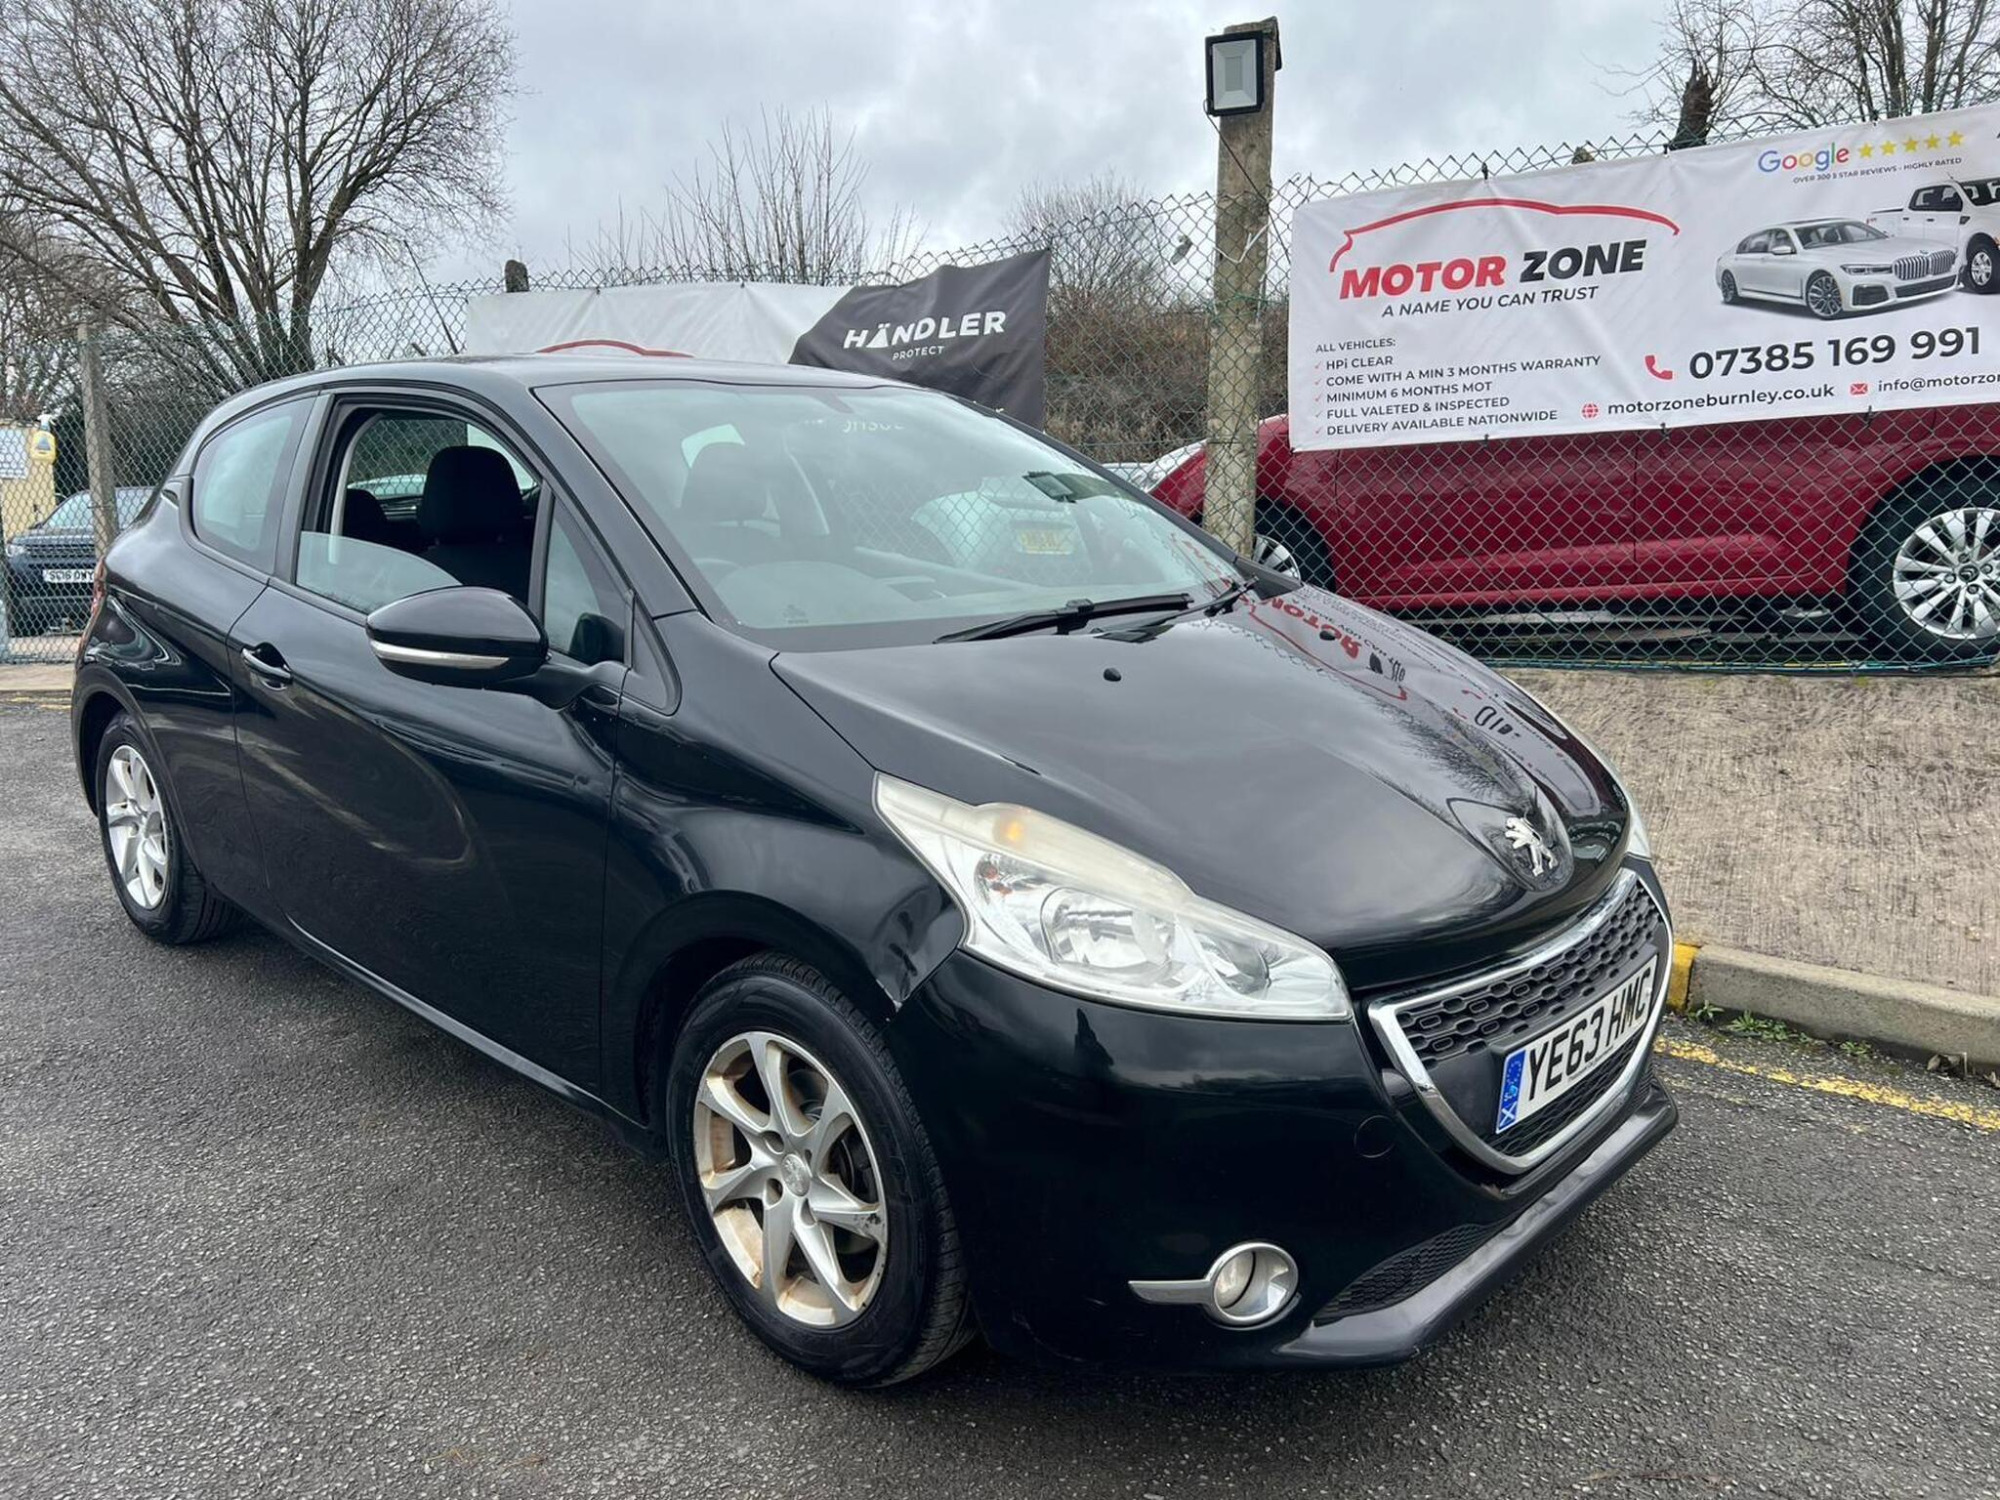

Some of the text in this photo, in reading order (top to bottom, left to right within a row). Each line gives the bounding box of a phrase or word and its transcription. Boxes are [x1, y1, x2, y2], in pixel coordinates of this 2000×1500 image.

[1758, 142, 1850, 172] Google
[1793, 175, 1815, 184] OVER
[1838, 170, 1859, 179] STAR
[1860, 166, 1897, 176] REVIEWS
[1903, 161, 1934, 170] HIGHLY
[1934, 157, 1962, 166] RATED
[1339, 239, 1647, 300] MOTOR ZONE
[1381, 286, 1599, 318] A NAME YOU CAN TRUST
[843, 311, 1007, 349] HÄNDLER
[892, 345, 945, 361] PROTECT
[1316, 338, 1396, 353] ALL VEHICLES:
[1689, 327, 1979, 379] 07385 169 991
[1326, 355, 1394, 370] HPi CLEAR
[1326, 355, 1601, 387] COME WITH A MIN 3 MONTHS WARRANTY
[1326, 381, 1493, 403] MINIMUM 6 MONTHS MOT
[1607, 384, 1835, 415] motorzoneburnley.co.uk
[1326, 397, 1510, 419] FULL VALETED & INSPECTED
[1326, 410, 1558, 436] DELIVERY AVAILABLE NATIONWIDE
[1528, 1006, 1606, 1101] YE63
[1605, 966, 1652, 1047] HMC
